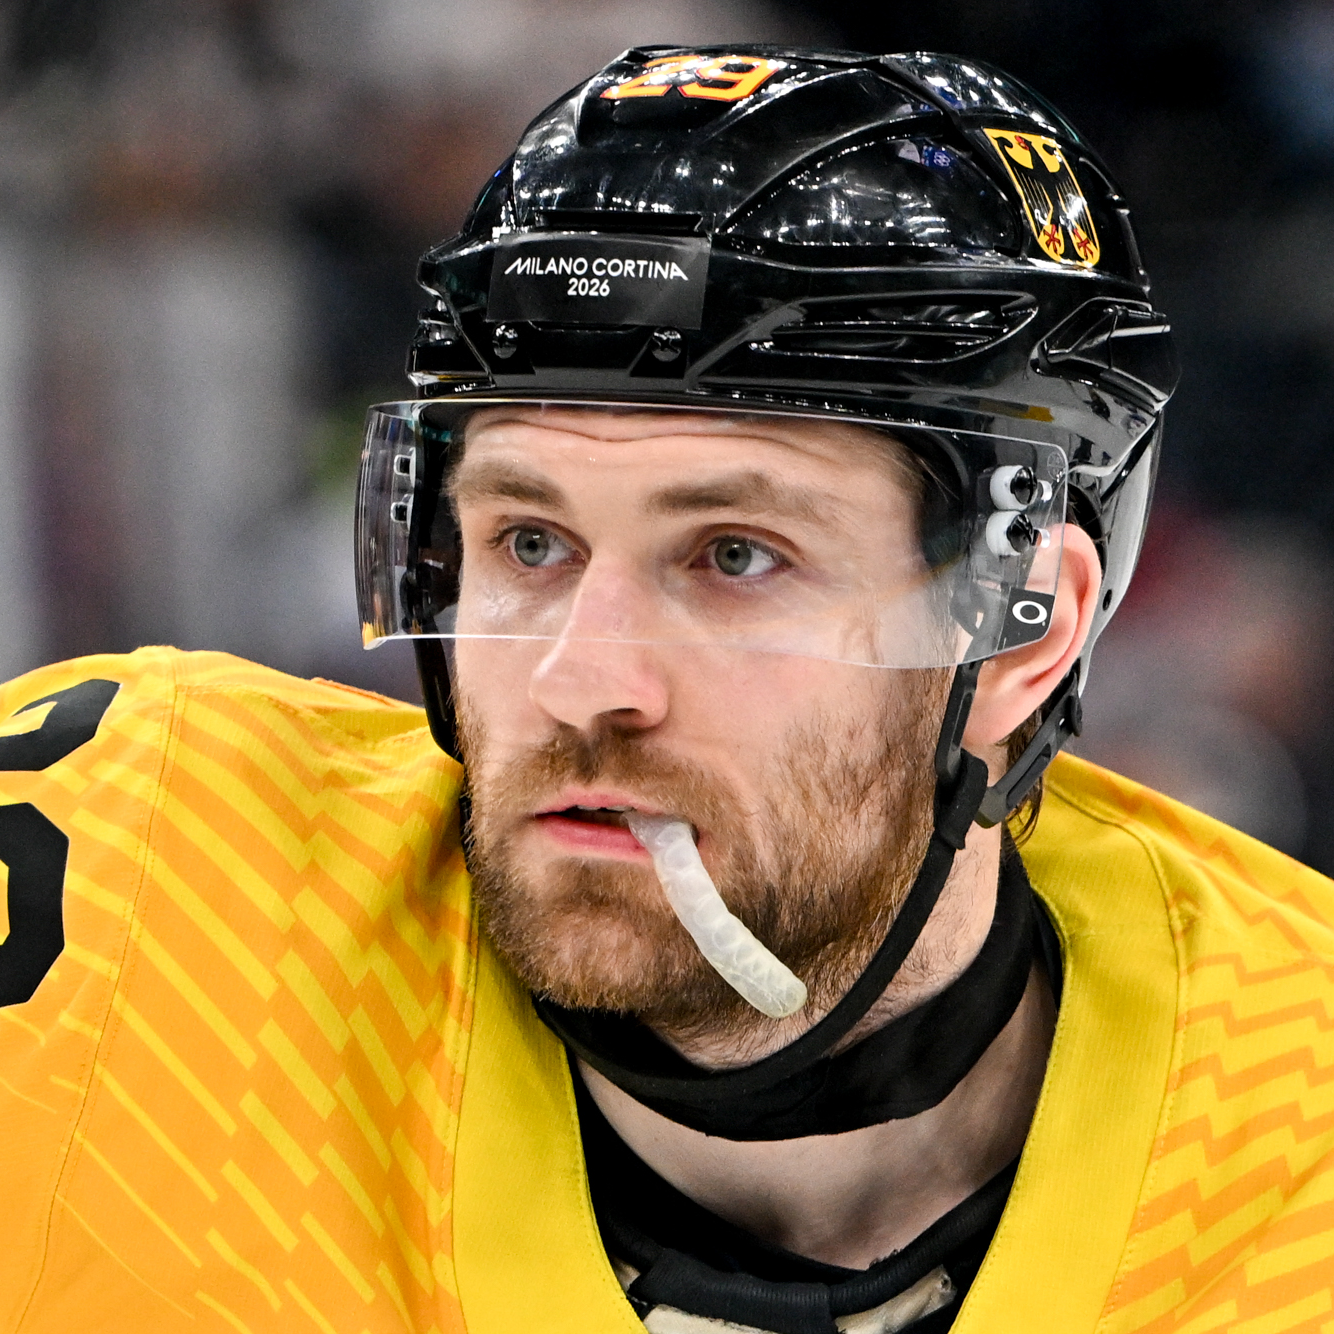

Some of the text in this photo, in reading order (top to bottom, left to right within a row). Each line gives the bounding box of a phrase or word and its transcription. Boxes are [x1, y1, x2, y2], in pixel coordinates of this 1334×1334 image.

[600, 55, 779, 102] 29
[504, 257, 689, 282] MILANO CORTINA
[567, 277, 611, 297] 2026
